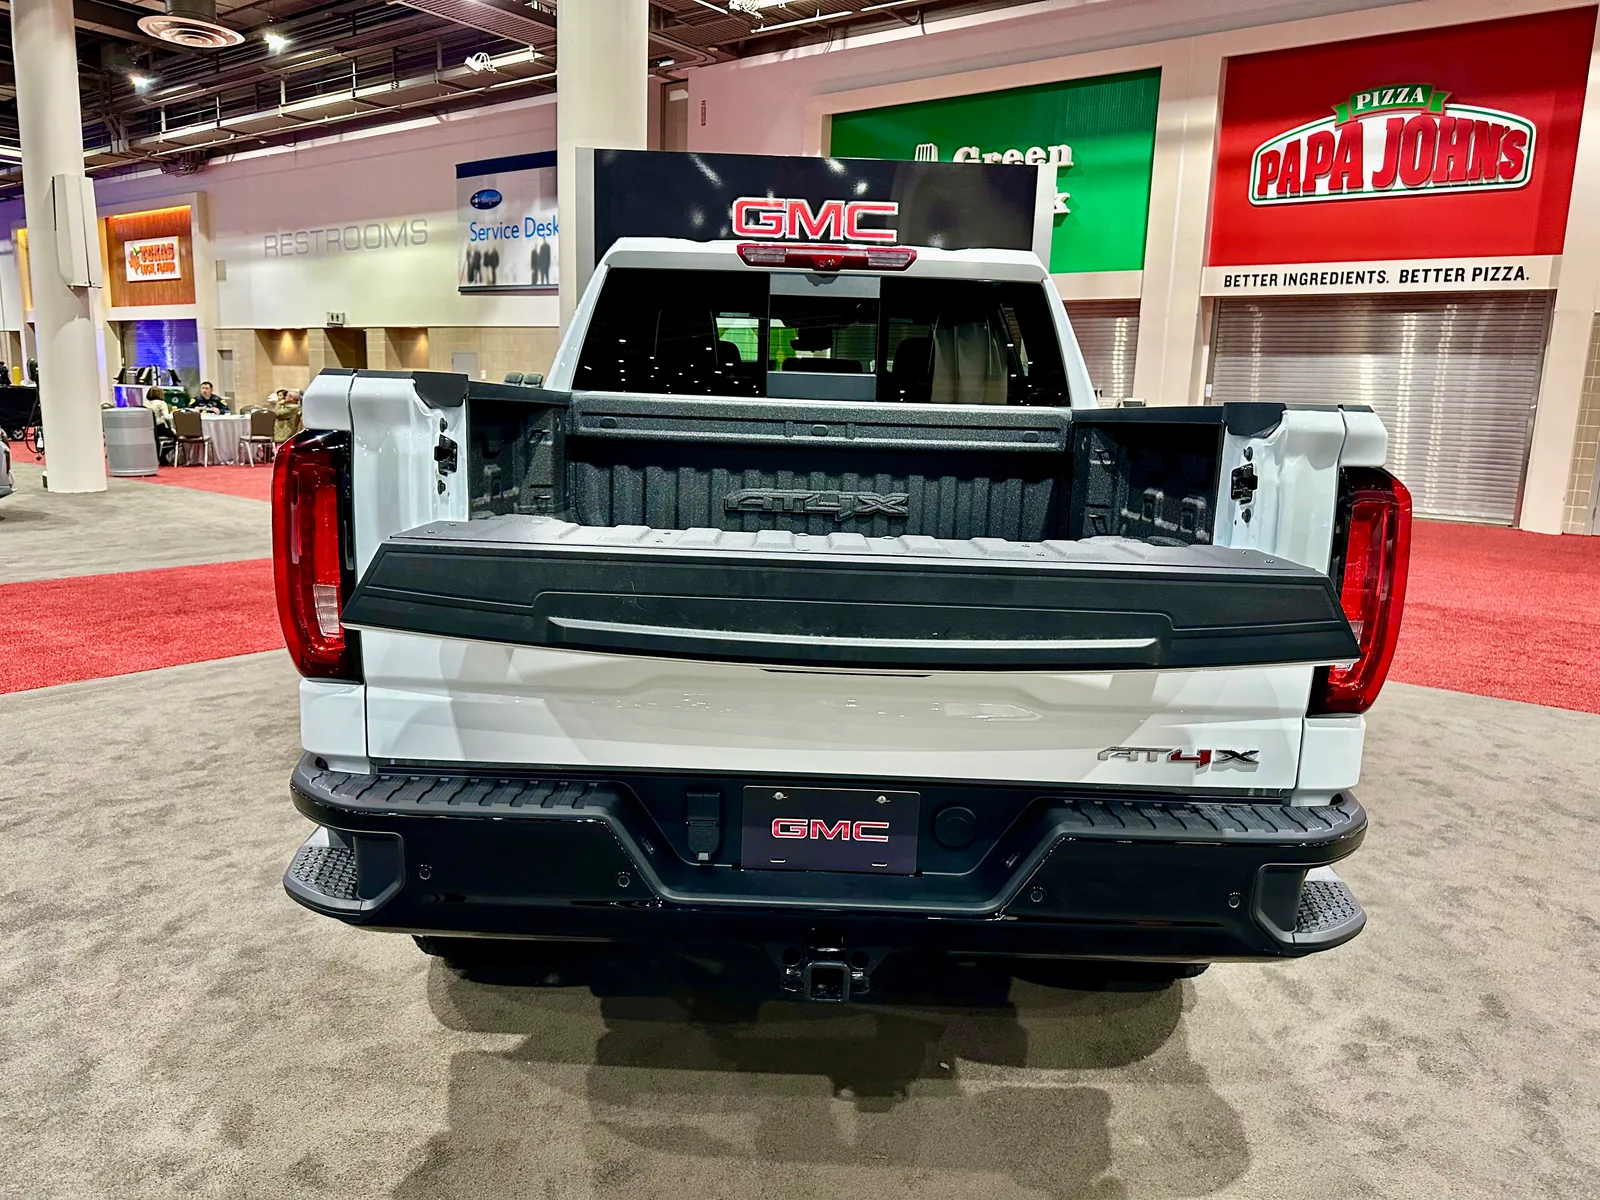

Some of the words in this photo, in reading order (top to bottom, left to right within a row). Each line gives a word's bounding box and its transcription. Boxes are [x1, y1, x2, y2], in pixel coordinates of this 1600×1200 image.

[1356, 87, 1425, 111] PIZZA
[953, 144, 1074, 167] Green
[1257, 121, 1364, 196] PAPA
[1371, 115, 1528, 190] JOHN'S
[469, 221, 520, 242] Service
[524, 215, 559, 239] Desk
[732, 196, 899, 242] GMC
[264, 218, 429, 259] RESTROOMS
[1223, 273, 1279, 288] BETTER
[1282, 269, 1390, 287] INGREDIENTS.
[1398, 267, 1466, 284] BETTER
[1471, 264, 1531, 282] PIZZA.
[724, 488, 910, 522] AT4X
[1097, 746, 1260, 769] AT4X
[771, 817, 890, 842] GMC
